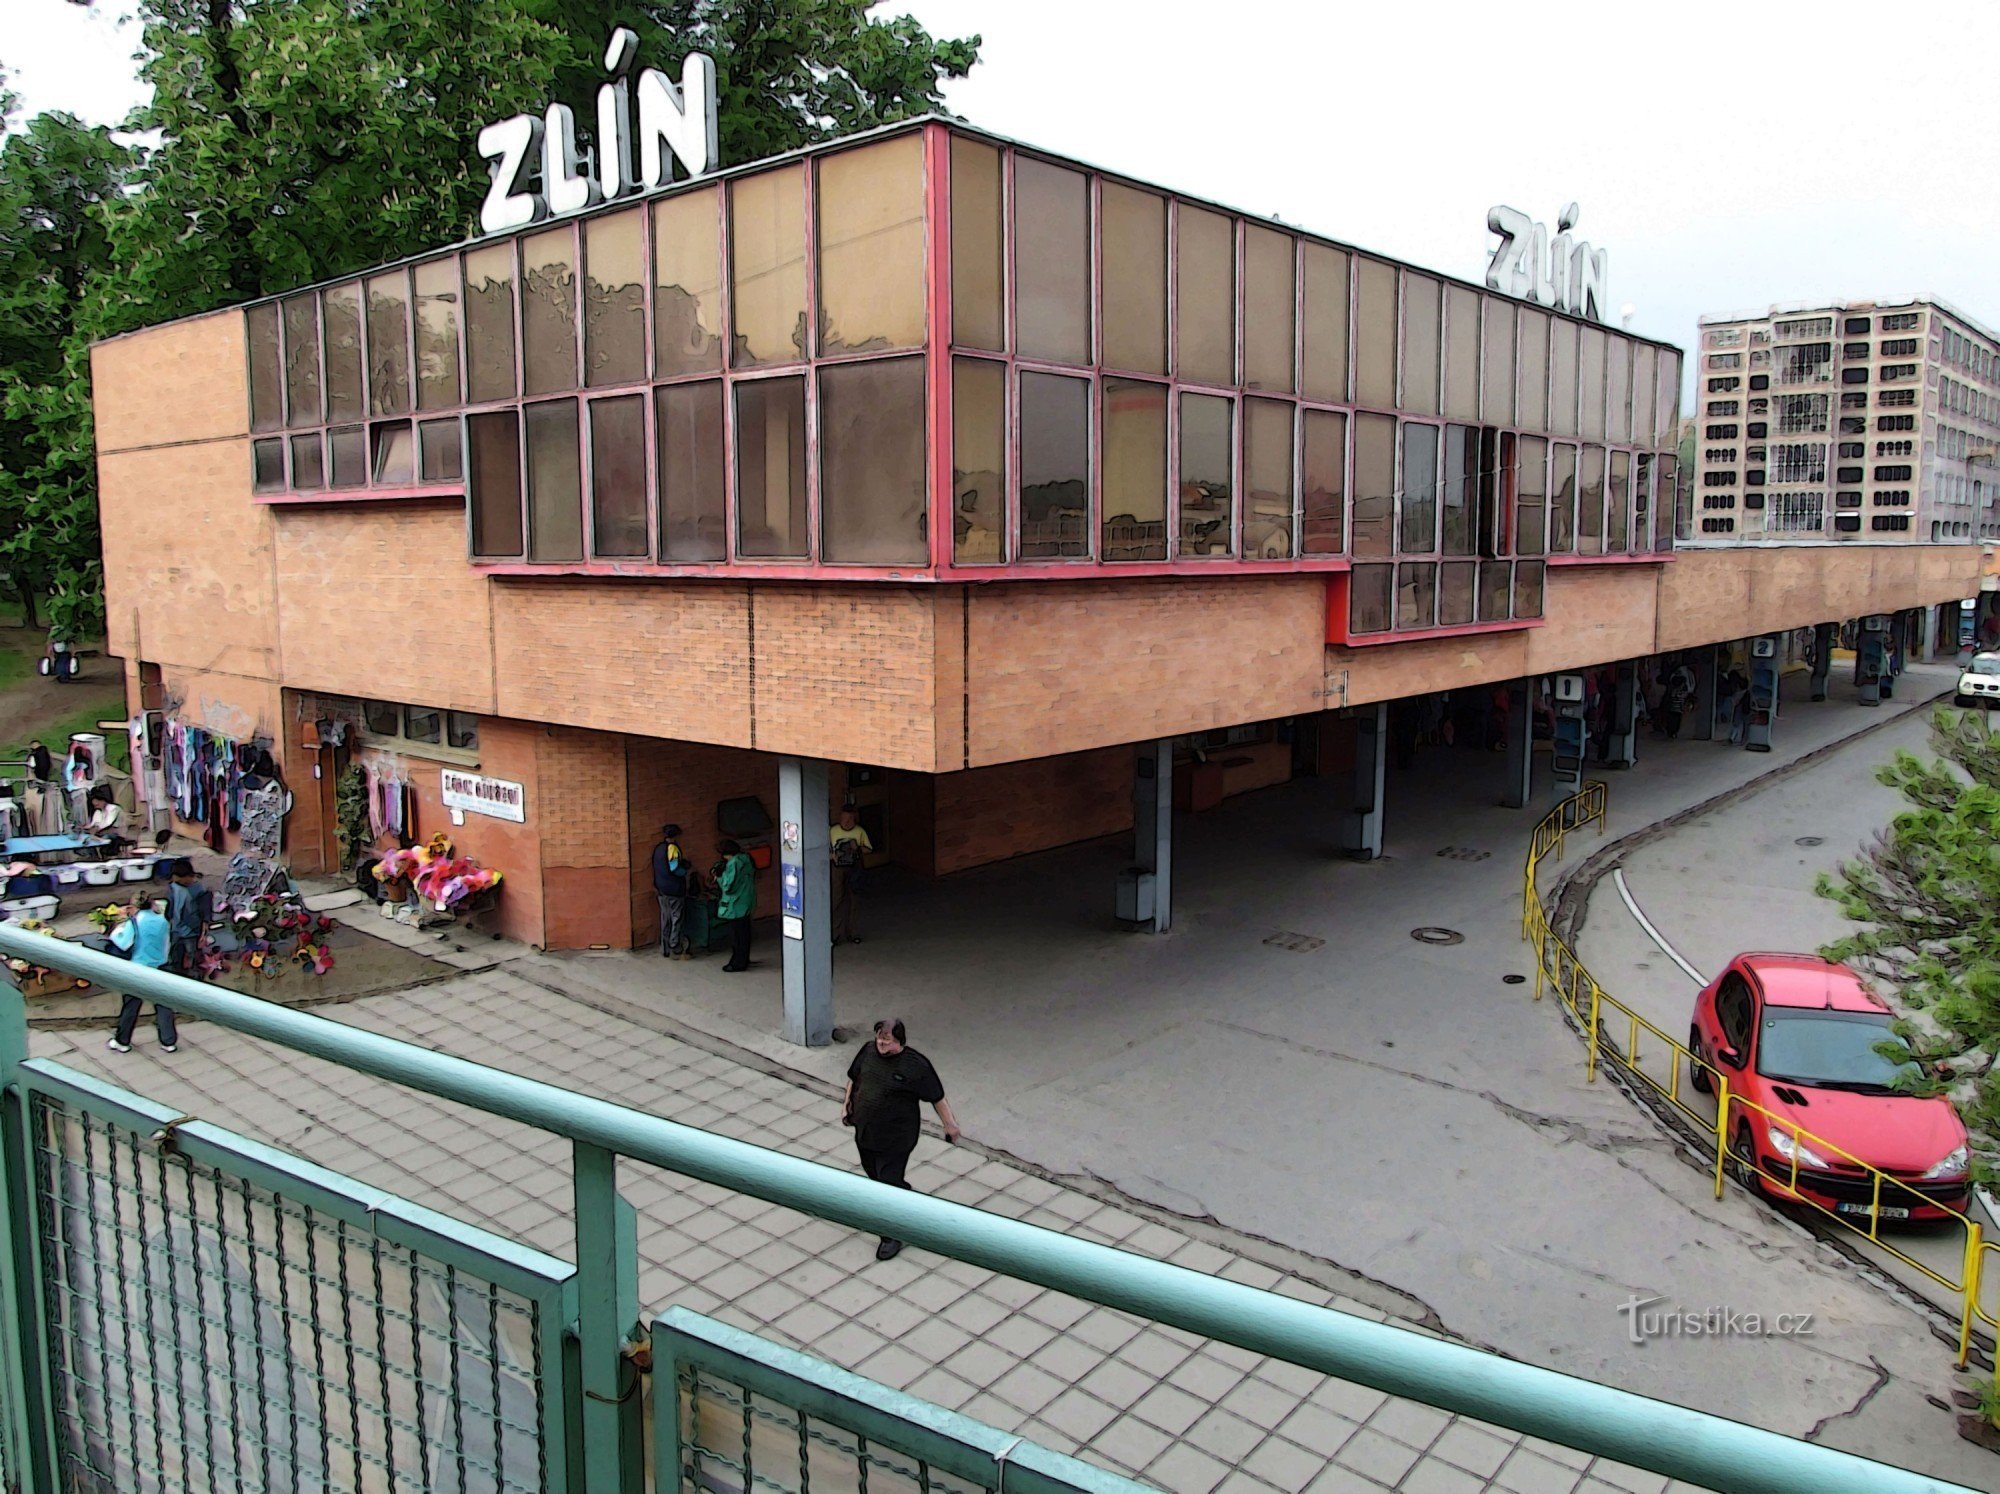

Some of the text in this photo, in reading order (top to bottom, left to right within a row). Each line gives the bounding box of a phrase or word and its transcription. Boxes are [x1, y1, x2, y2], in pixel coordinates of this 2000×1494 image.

[478, 27, 714, 232] ZLÍN
[1487, 202, 1607, 321] ZLÍN
[1758, 641, 1768, 654] 2
